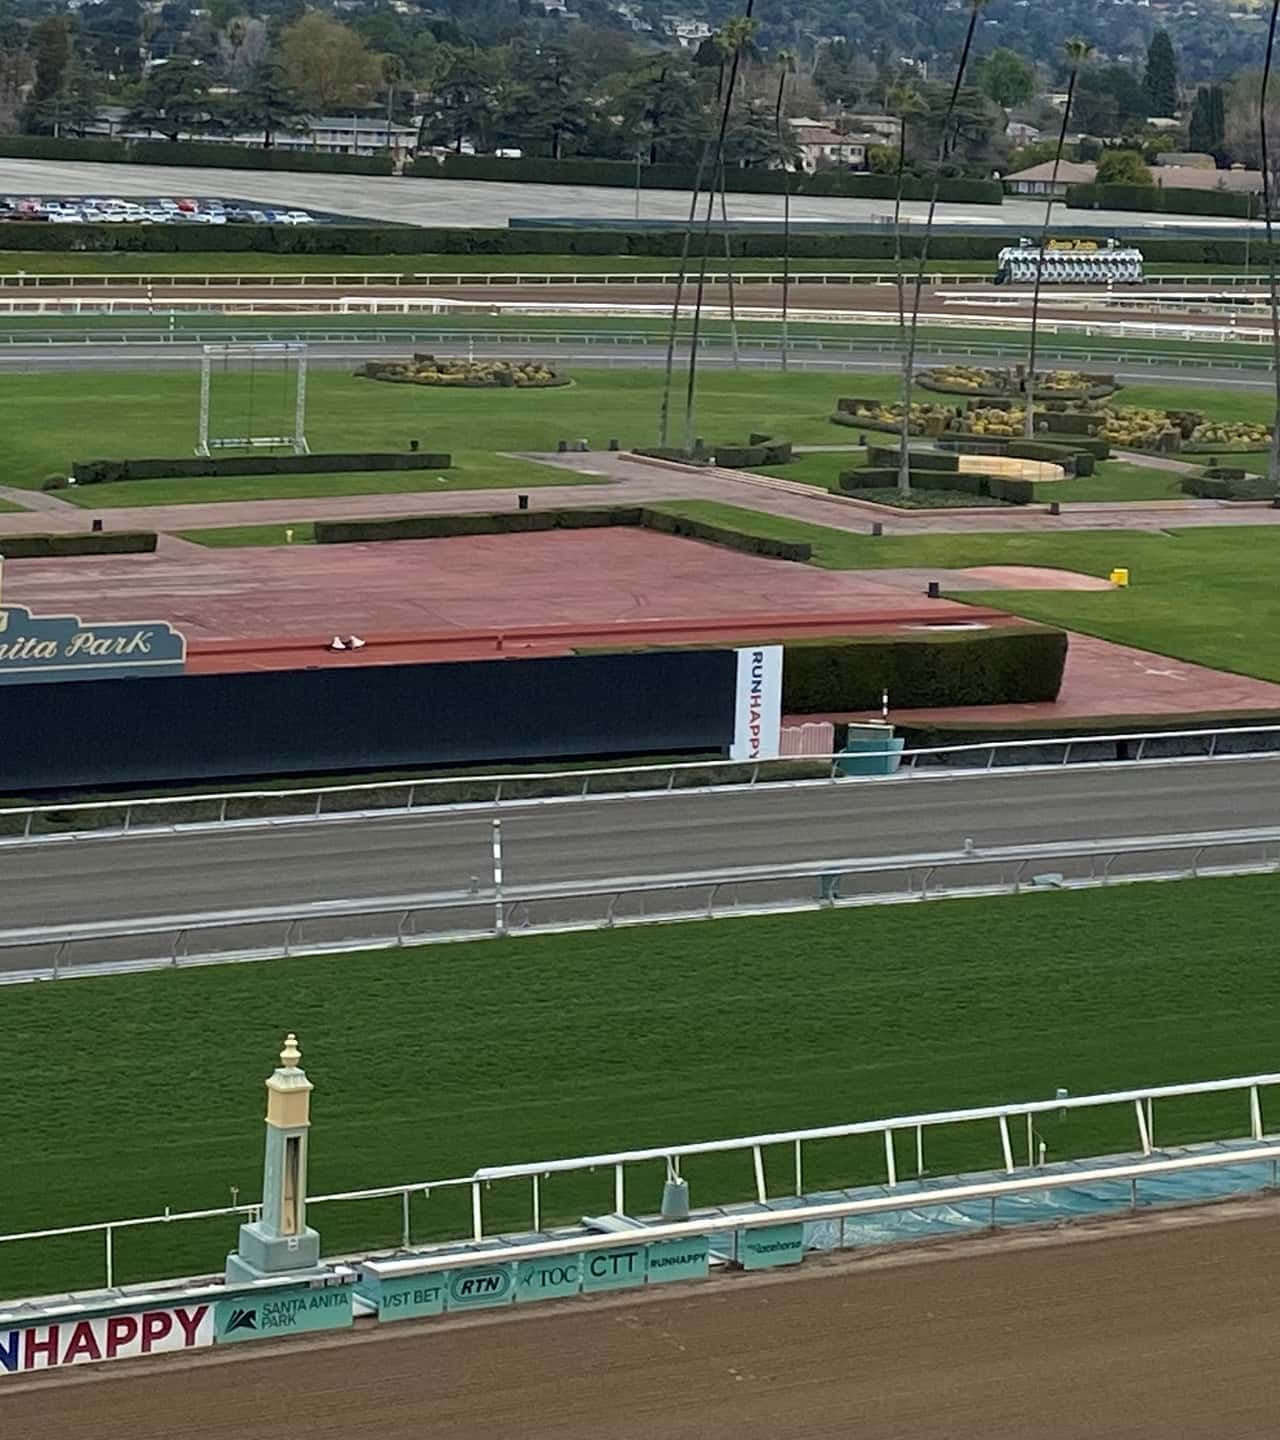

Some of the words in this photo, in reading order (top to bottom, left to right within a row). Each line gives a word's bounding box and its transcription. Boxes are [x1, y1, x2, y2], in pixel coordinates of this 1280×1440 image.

[65, 631, 154, 657] Park
[590, 1252, 638, 1277] CTT
[650, 1253, 706, 1268] RUNHAPPY
[461, 1276, 500, 1295] RTN
[538, 1265, 577, 1288] TOC
[262, 1299, 308, 1317] SANTA
[308, 1292, 349, 1310] ANITA
[383, 1291, 412, 1308] 1/ST
[413, 1287, 441, 1304] BET
[261, 1313, 297, 1330] PARK
